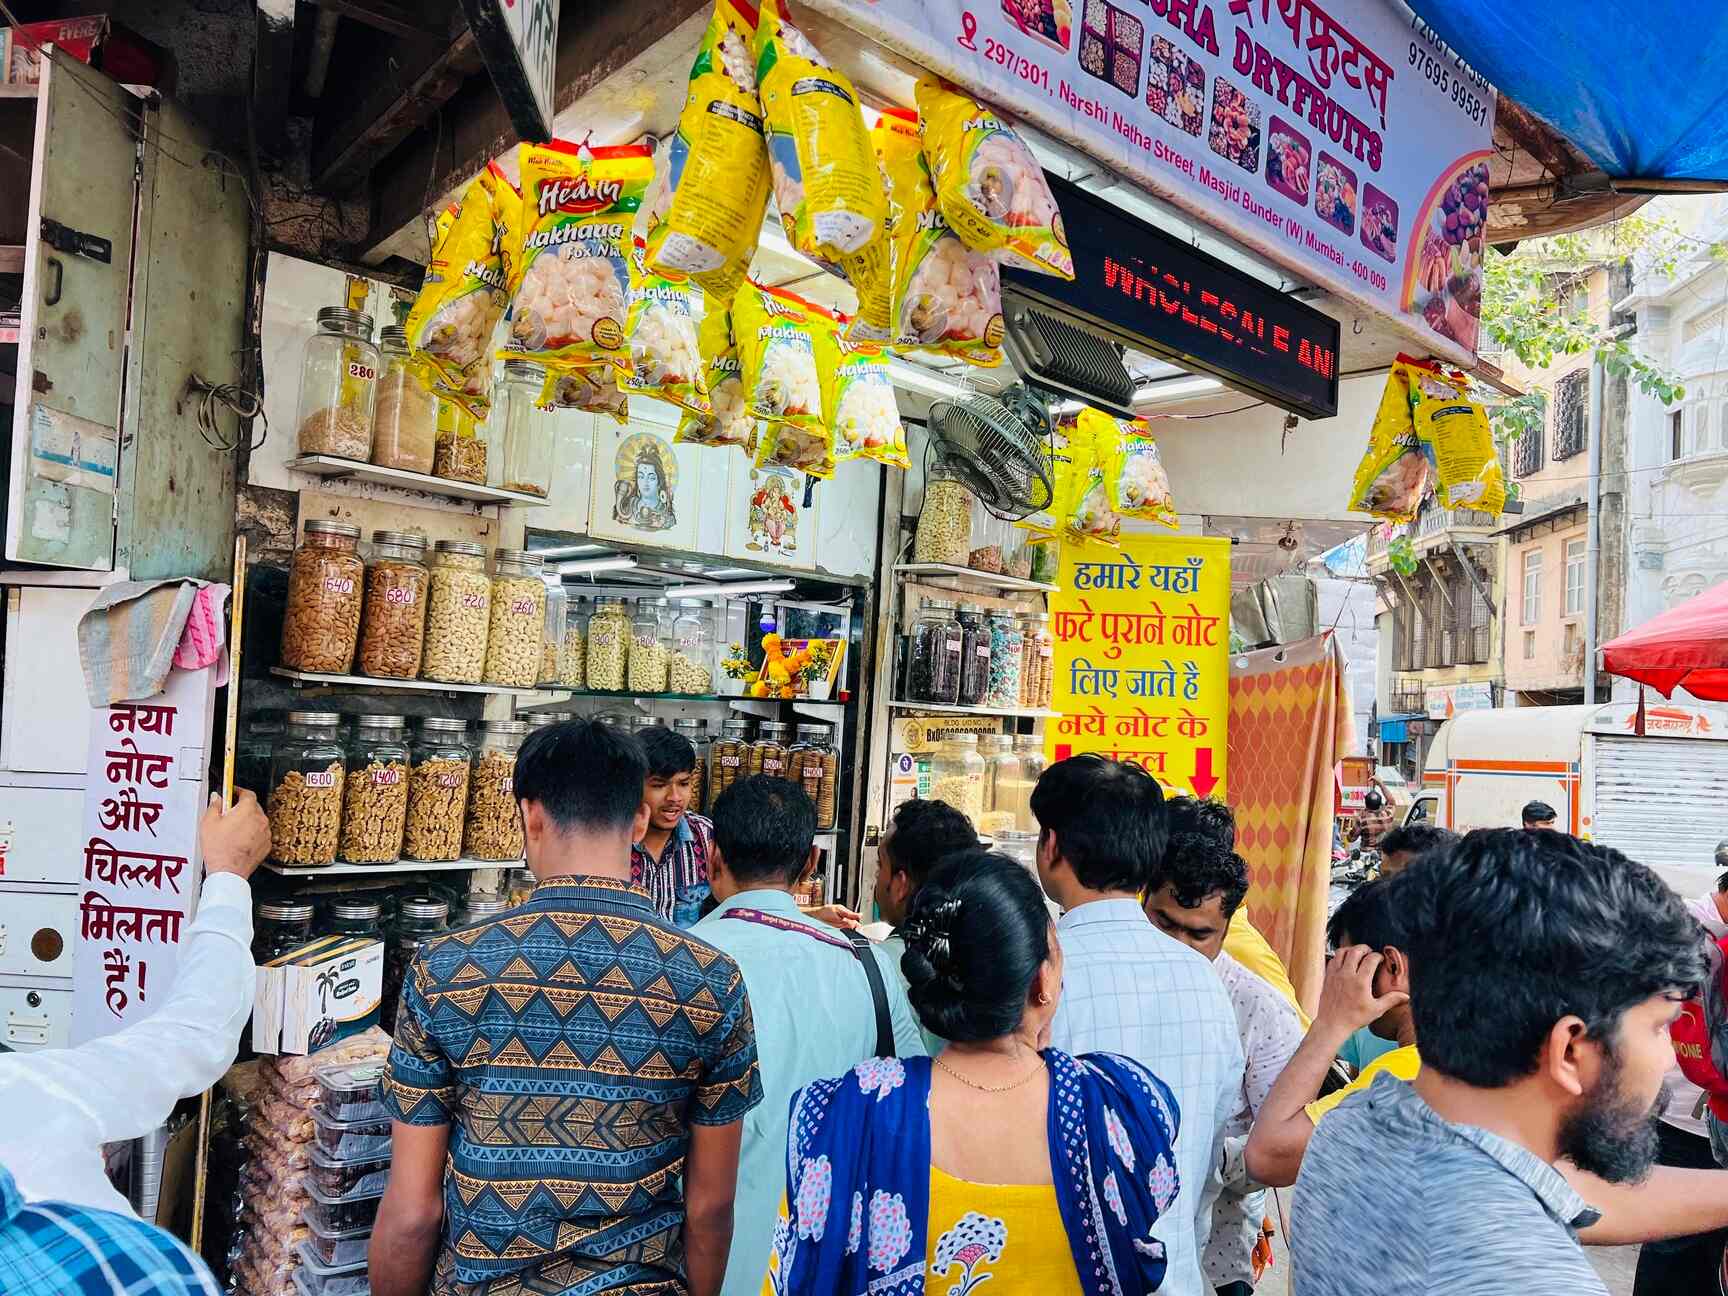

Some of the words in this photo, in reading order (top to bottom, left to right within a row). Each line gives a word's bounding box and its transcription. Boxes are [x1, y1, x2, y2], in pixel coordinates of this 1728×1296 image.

[1232, 26, 1383, 172] DRYFRUITS
[1408, 41, 1449, 93] 97695
[1451, 79, 1487, 127] 99581
[1058, 79, 1108, 125] Narshi
[1112, 111, 1152, 151] Natha
[1154, 141, 1195, 184] Street,
[1199, 166, 1240, 203] Masjid
[1242, 191, 1284, 227] Bunder
[1285, 217, 1303, 246] (W)
[1306, 230, 1345, 267] Mumbai
[1352, 260, 1369, 281] 400
[1370, 274, 1387, 291] 009
[522, 221, 623, 253] Makhana
[351, 364, 375, 380] 280
[326, 578, 352, 594] 640
[1073, 553, 1143, 590] हमारे
[1149, 558, 1204, 593] यहाँ
[385, 589, 412, 604] 680
[463, 593, 487, 609] 720
[515, 601, 536, 615] 760
[1055, 598, 1095, 643] फटे
[1100, 601, 1166, 659] पुराने
[1171, 603, 1220, 646] नोट
[1070, 657, 1120, 698] लिए
[1125, 660, 1177, 697] जाते
[109, 703, 177, 736] नया
[1057, 705, 1108, 736] नये
[1115, 707, 1170, 737] नोट
[1176, 708, 1210, 738] के
[105, 737, 173, 788] नोट
[371, 770, 397, 784] 1400
[98, 787, 163, 838] और
[84, 836, 188, 894] चिल्लर
[80, 890, 184, 944] मिलता
